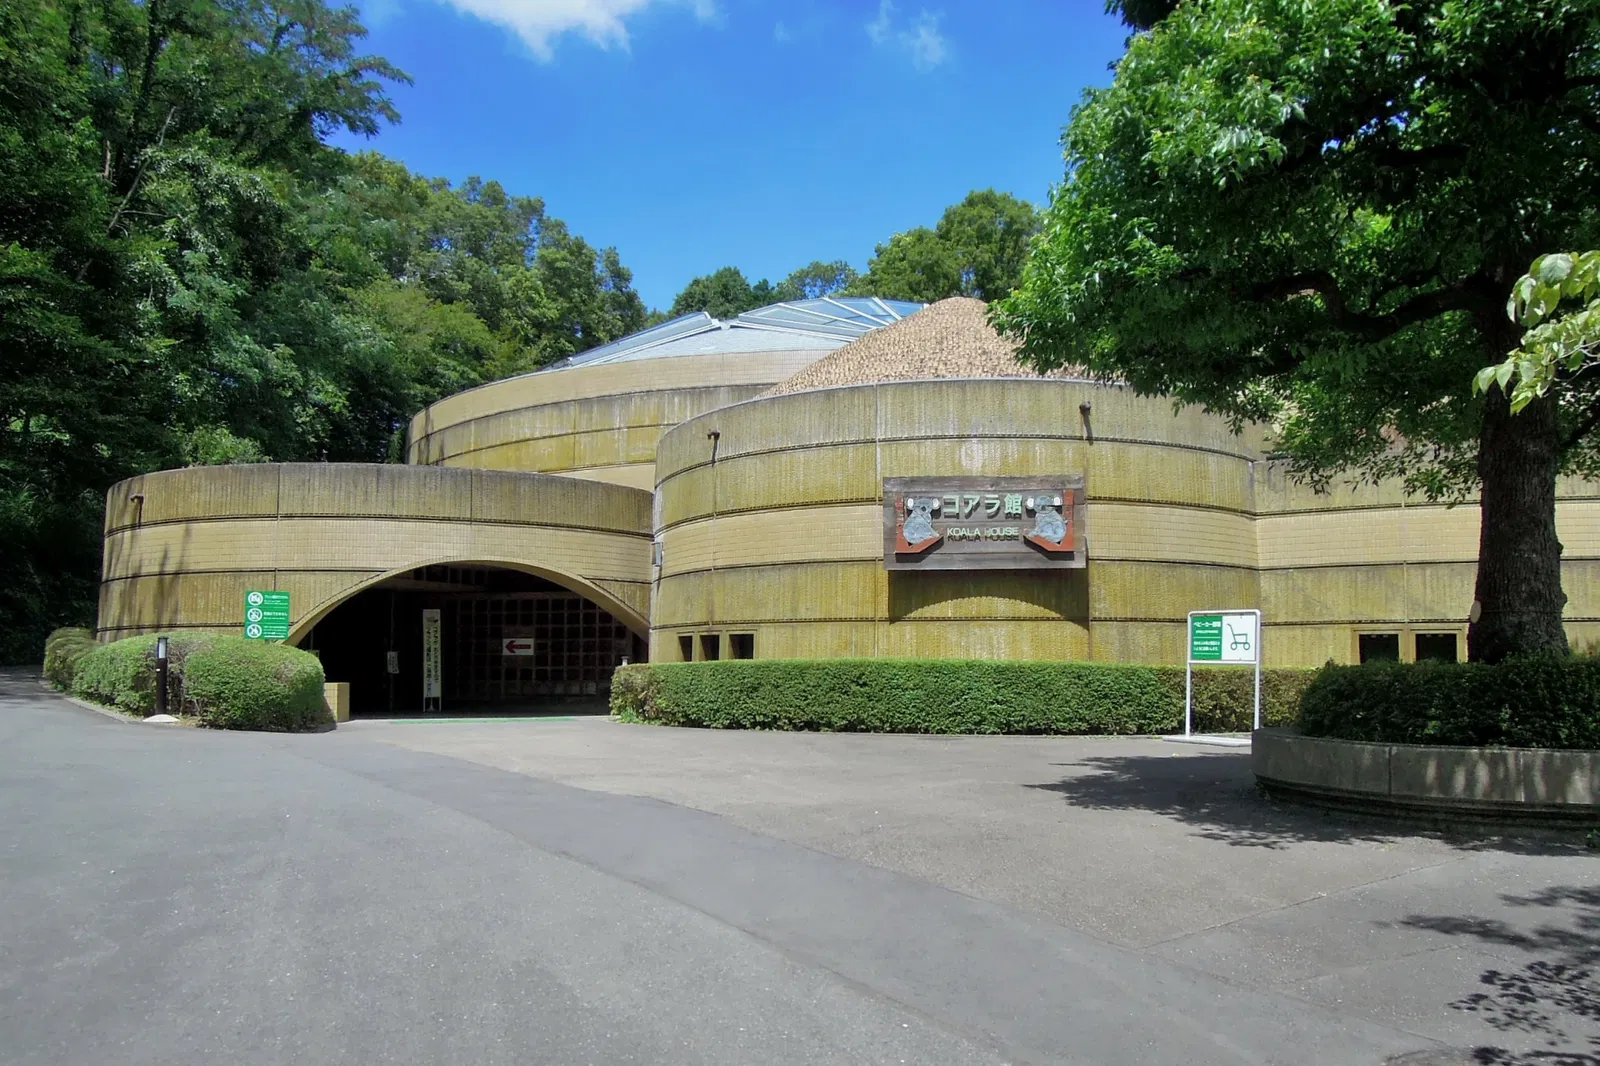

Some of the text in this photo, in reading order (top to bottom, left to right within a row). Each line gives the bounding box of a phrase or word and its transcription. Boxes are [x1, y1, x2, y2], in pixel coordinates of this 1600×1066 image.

[942, 493, 1022, 514] コアラ館
[947, 527, 1019, 536] KOALA HOUSE
